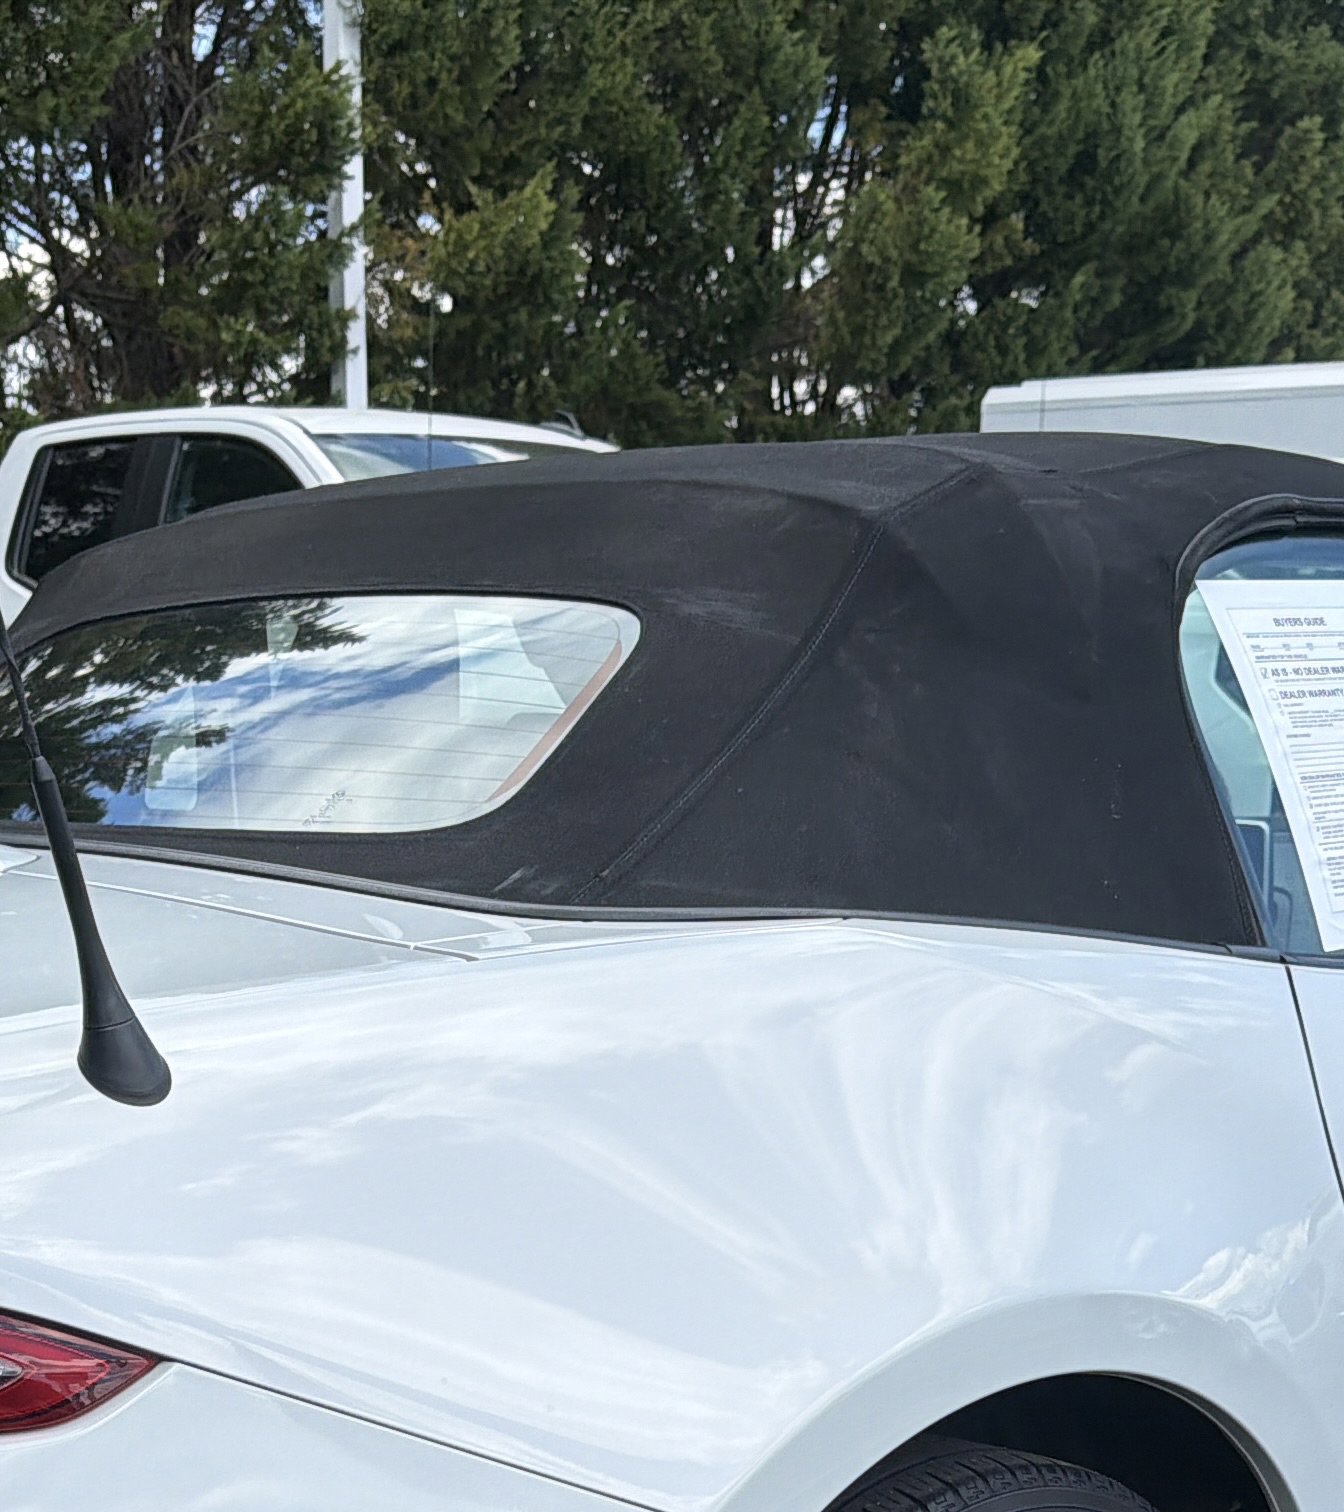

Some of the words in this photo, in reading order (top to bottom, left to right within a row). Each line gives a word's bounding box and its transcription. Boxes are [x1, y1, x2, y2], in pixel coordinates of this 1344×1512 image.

[1303, 616, 1327, 627] GUIDE
[1270, 667, 1281, 677] AS
[1293, 666, 1303, 676] NO
[1303, 665, 1331, 676] DEALER
[1278, 690, 1307, 700] DEALER
[1306, 688, 1344, 699] WARRANTY
